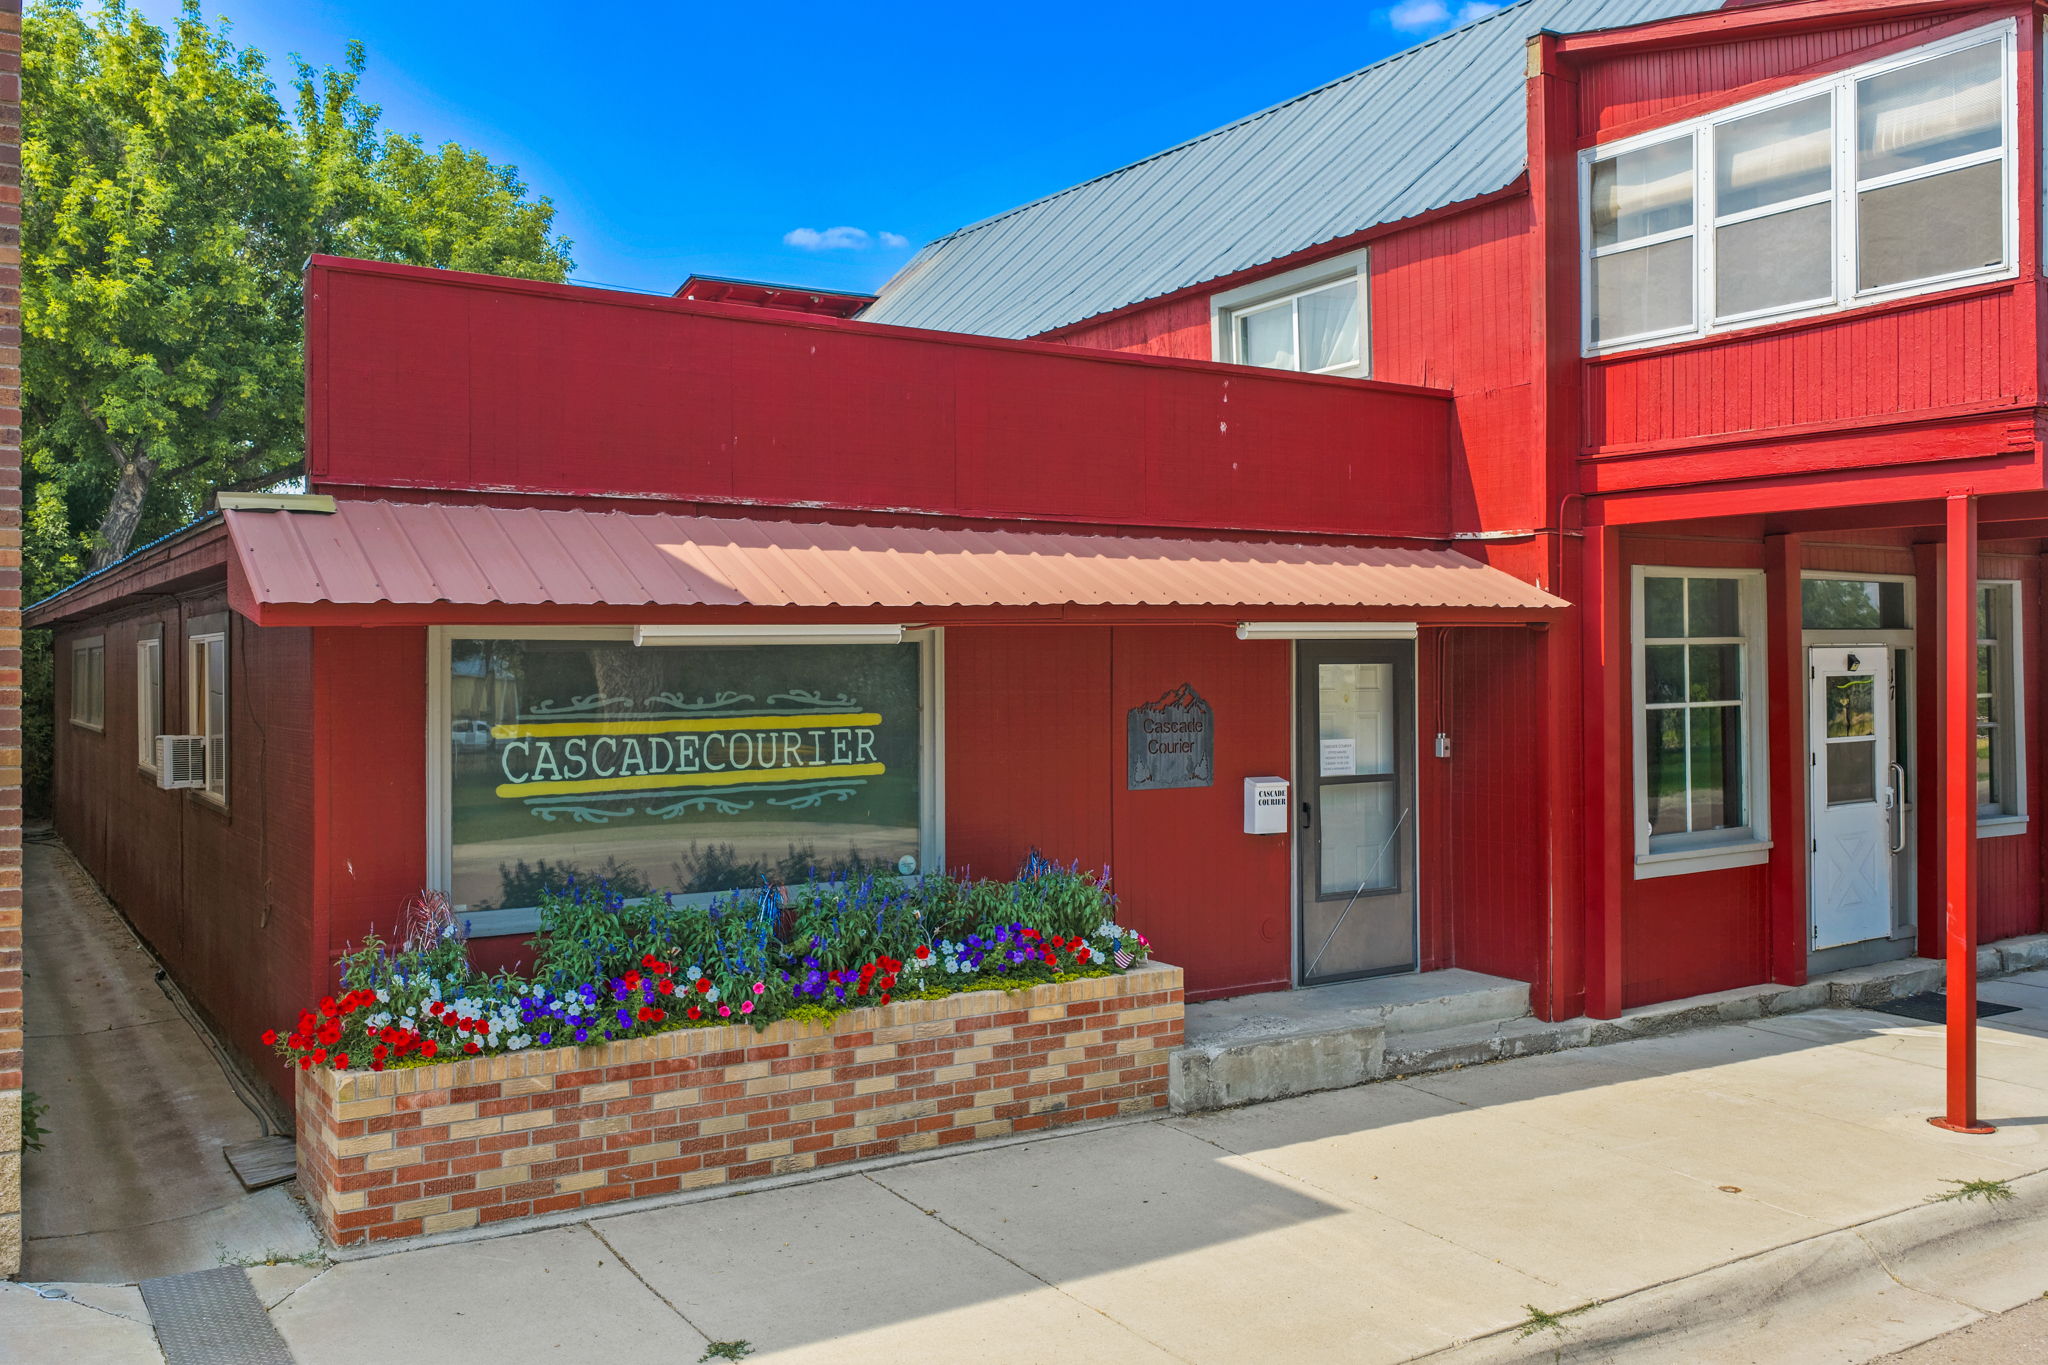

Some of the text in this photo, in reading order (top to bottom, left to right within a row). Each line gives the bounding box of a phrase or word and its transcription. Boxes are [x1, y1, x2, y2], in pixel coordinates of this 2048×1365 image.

[1143, 718, 1203, 734] Cascade
[1148, 738, 1195, 754] Courier
[1258, 790, 1286, 798] CASCADE
[1258, 798, 1286, 807] COURIER
